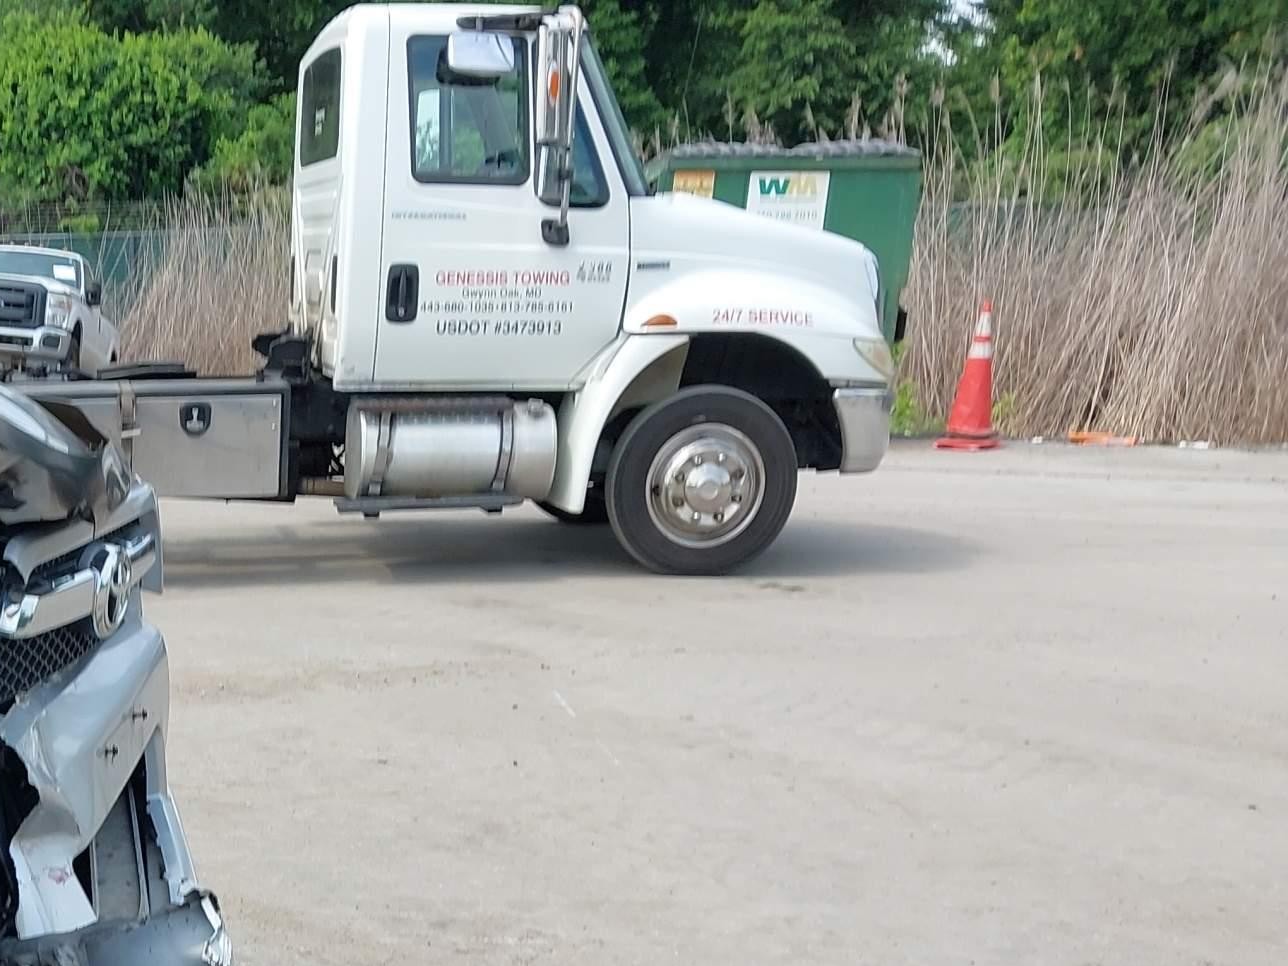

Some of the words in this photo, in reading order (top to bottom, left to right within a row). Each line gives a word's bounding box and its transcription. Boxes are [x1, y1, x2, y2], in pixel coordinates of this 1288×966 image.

[759, 176, 818, 195] WM
[513, 271, 571, 287] TOWING
[525, 288, 542, 298] MD
[712, 307, 743, 324] 24/7
[748, 309, 814, 327] SERVICE
[436, 320, 489, 336] USDOT
[494, 320, 562, 336] #3473913
